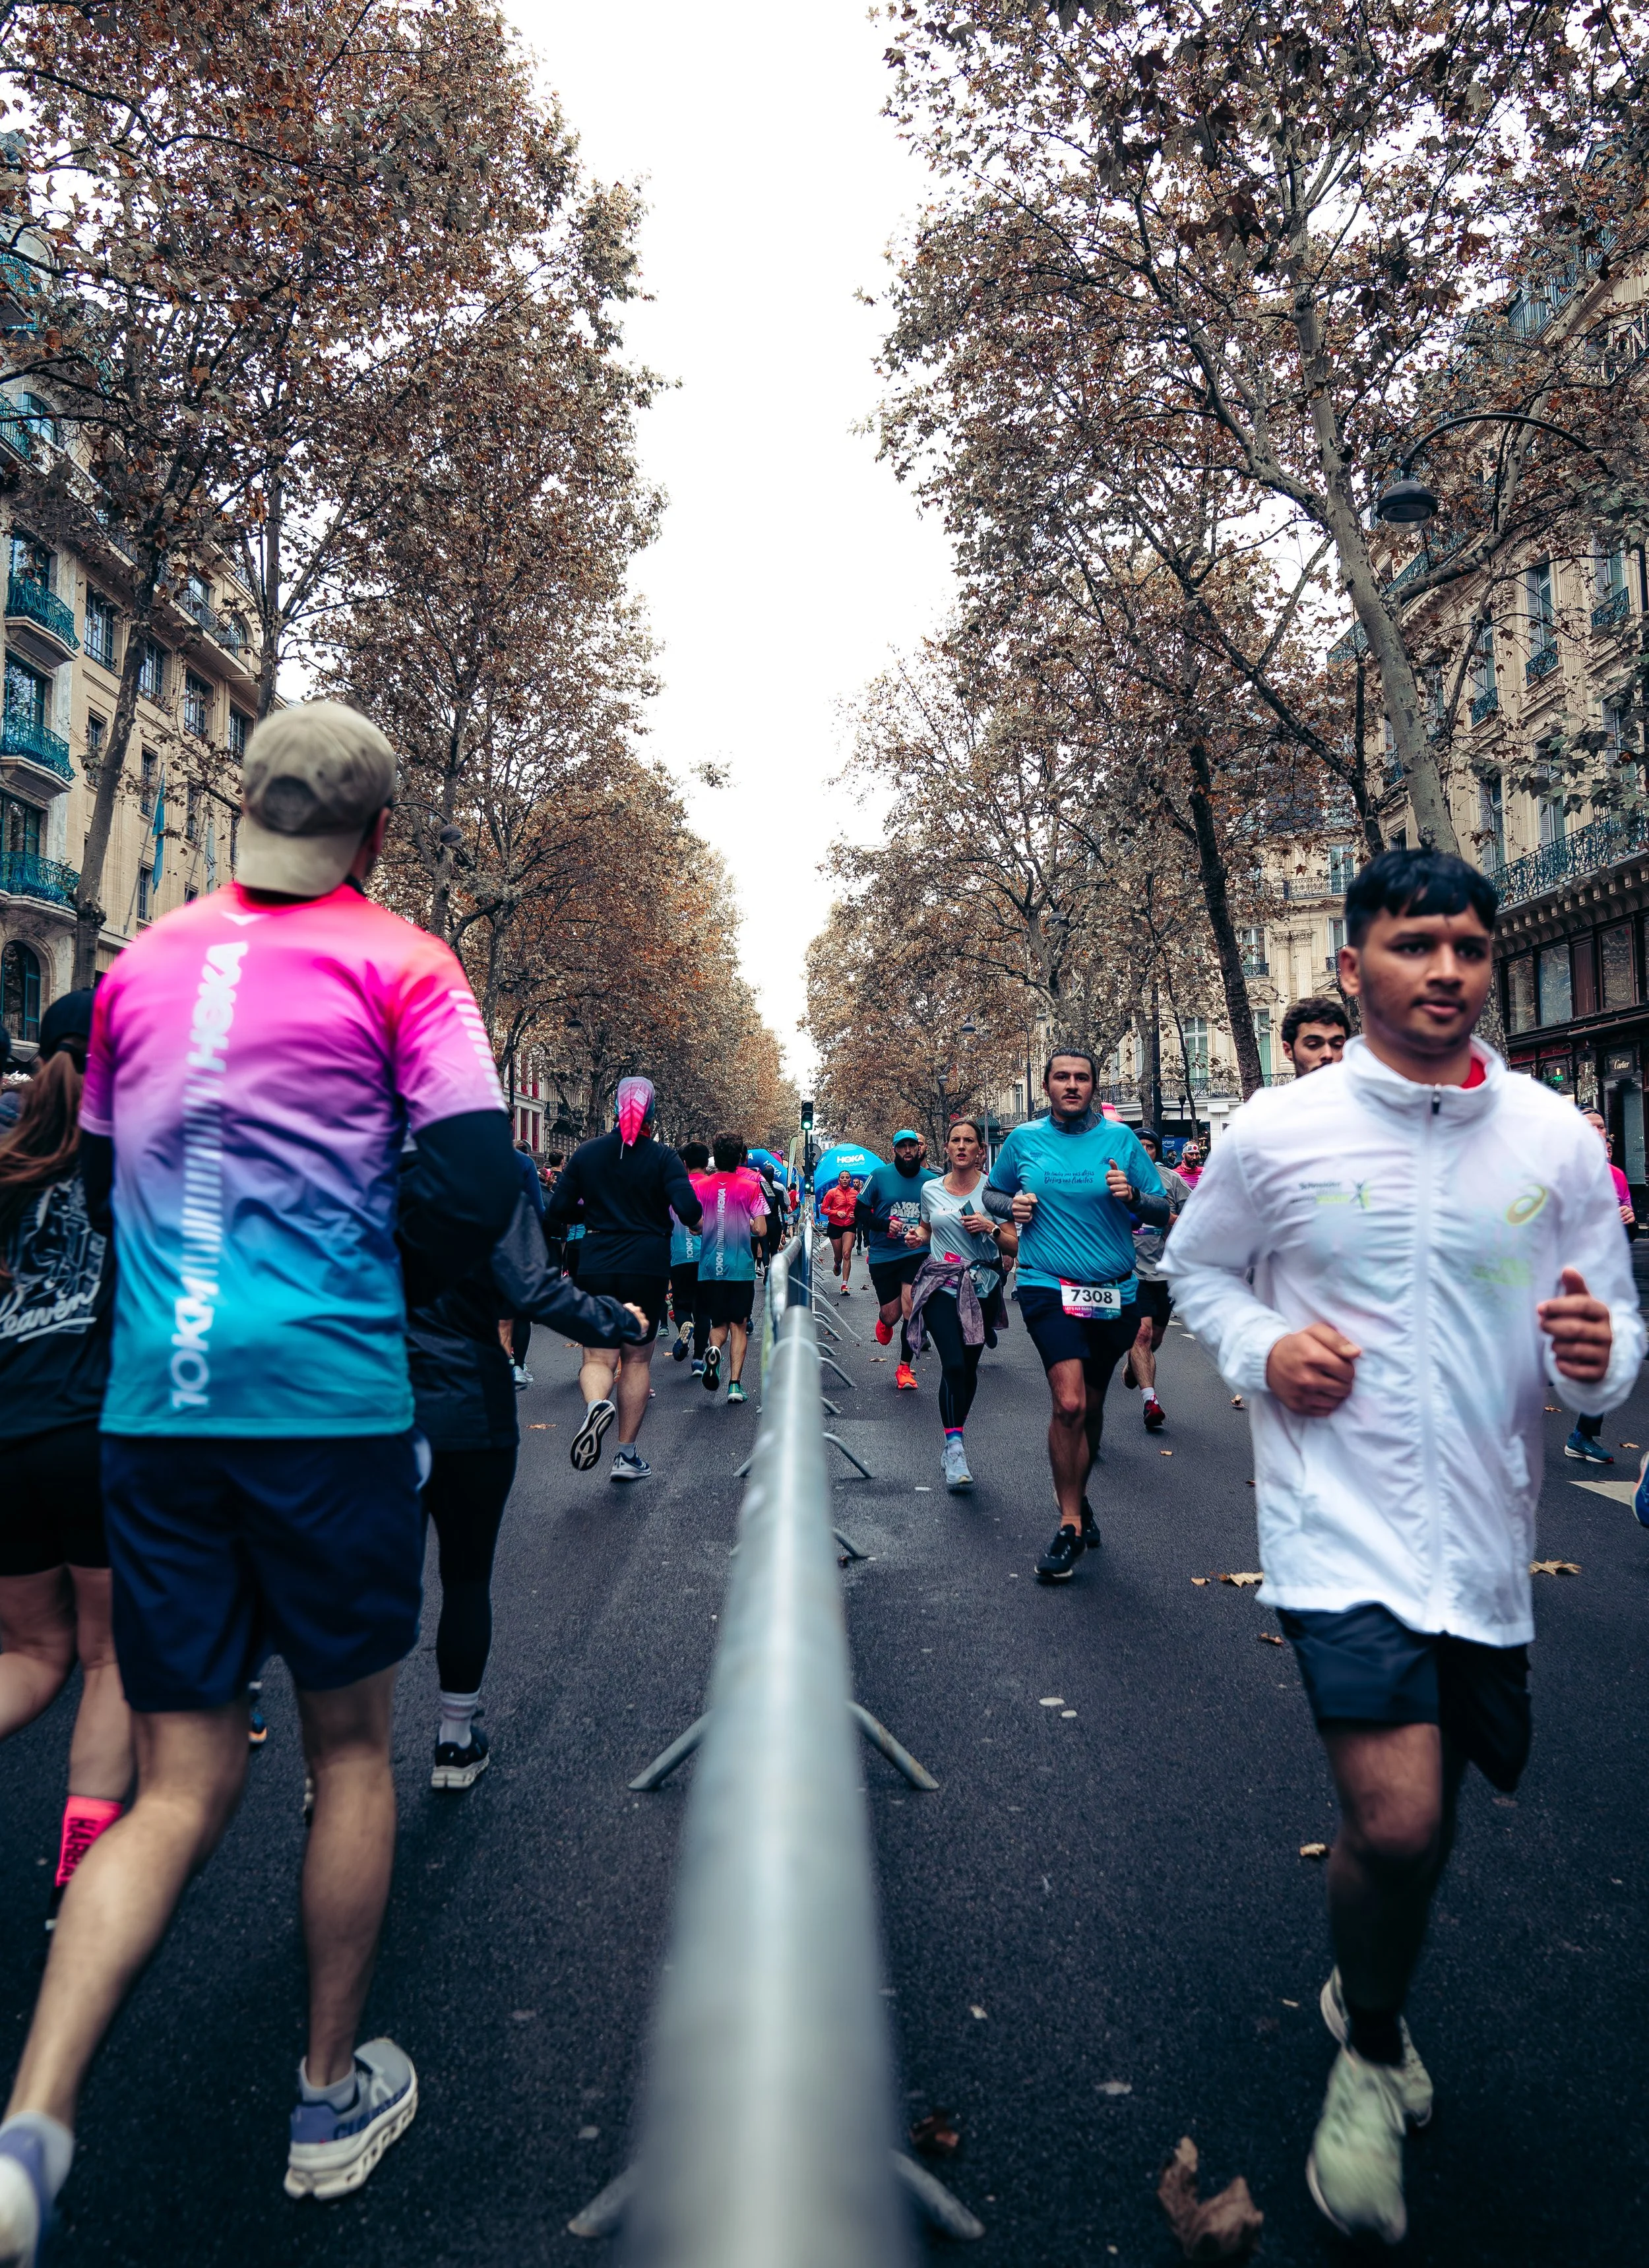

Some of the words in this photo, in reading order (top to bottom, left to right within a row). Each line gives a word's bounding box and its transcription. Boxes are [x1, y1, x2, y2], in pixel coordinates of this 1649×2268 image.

[186, 941, 249, 1074] HOKA
[1614, 1059, 1630, 1069] Cartier
[836, 1153, 865, 1163] HOKA
[902, 1202, 919, 1211] 10K
[890, 1208, 920, 1218] PARIS
[1071, 1289, 1113, 1304] 7308
[171, 1275, 219, 1407] 10KM
